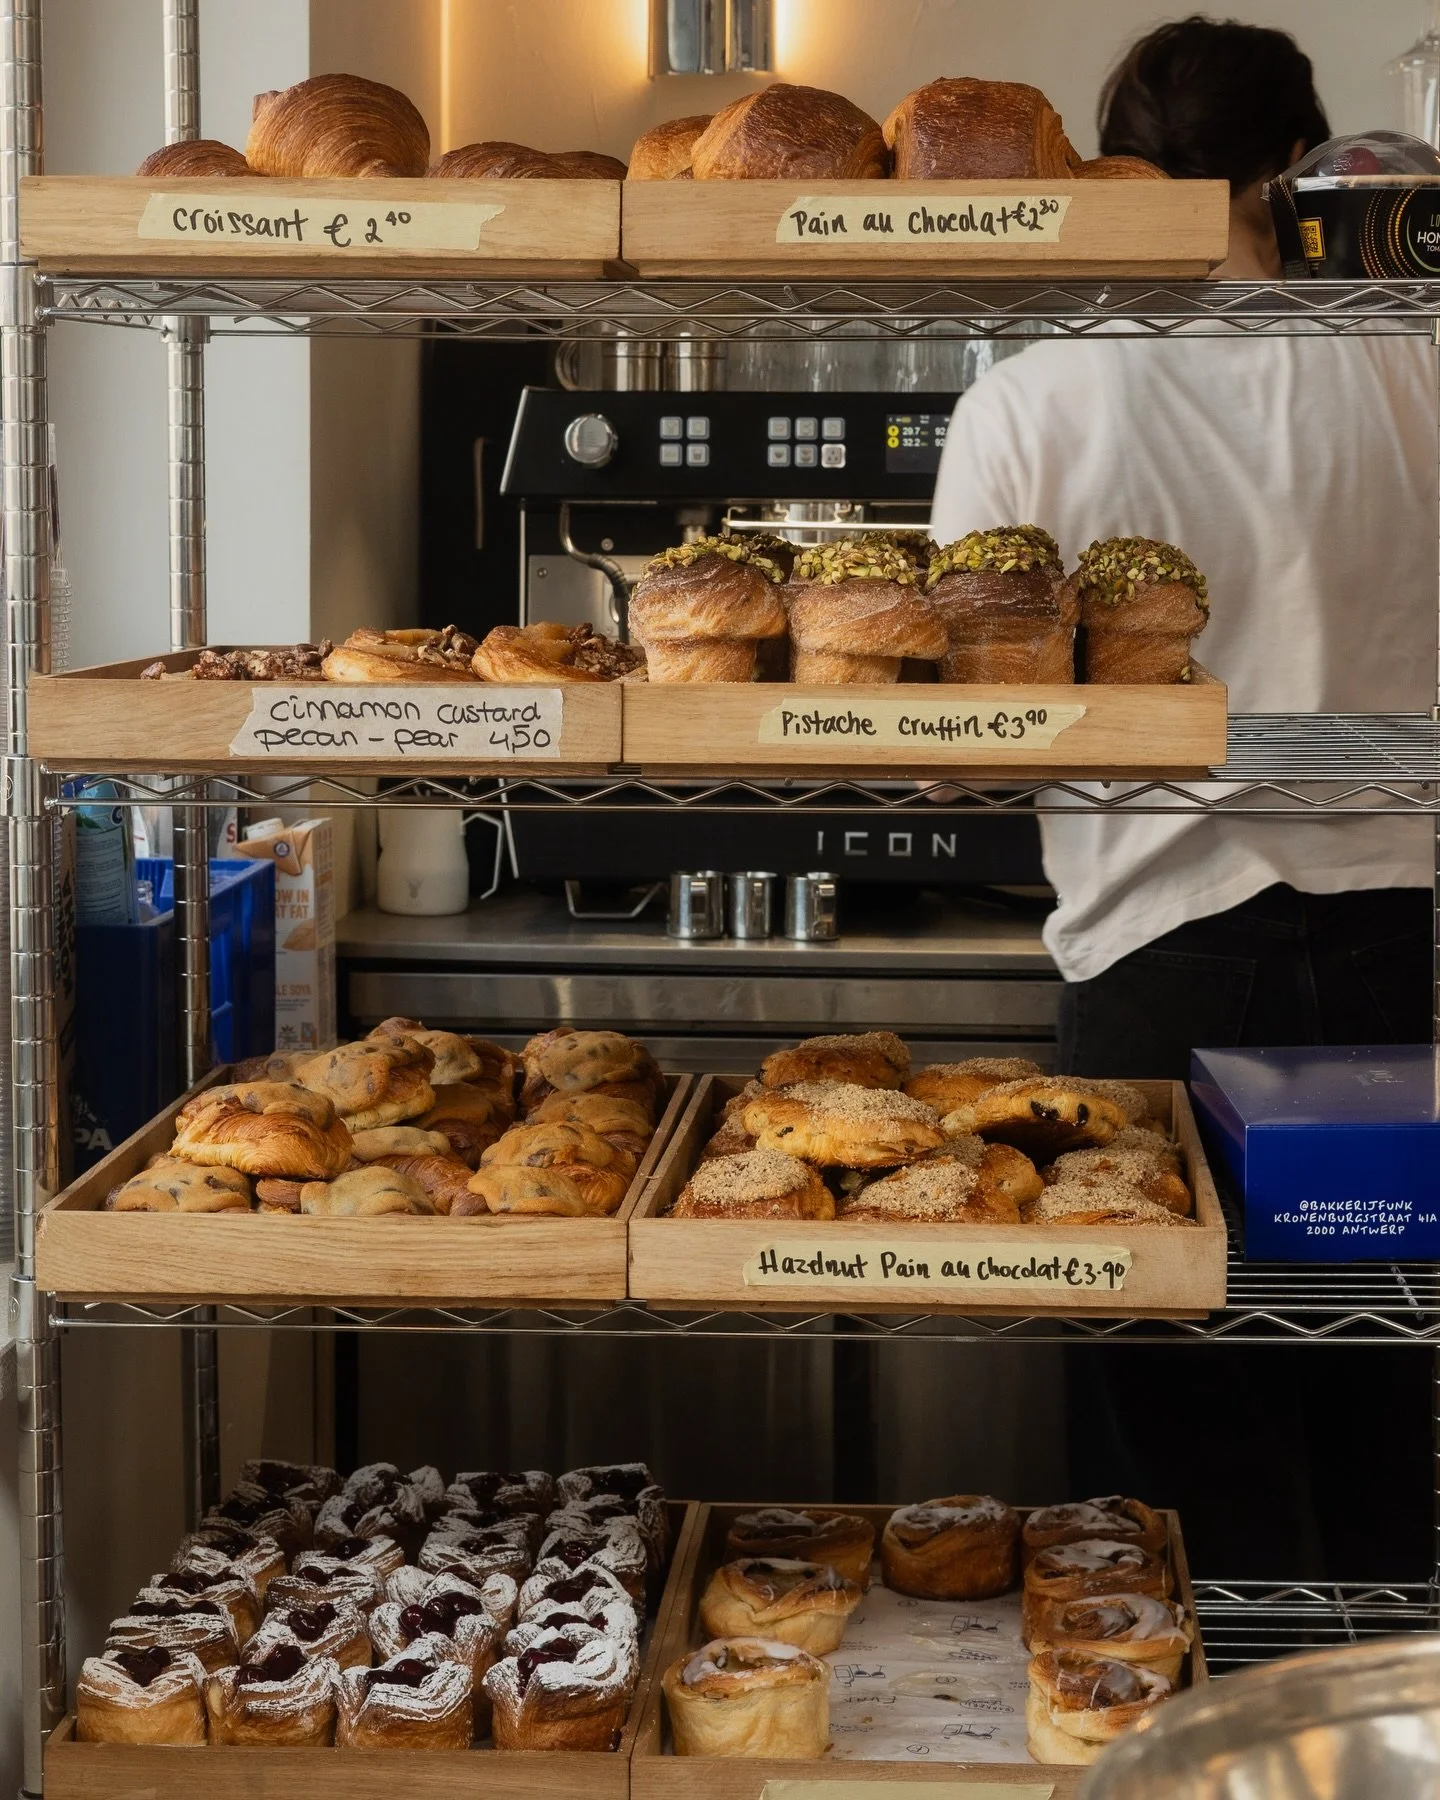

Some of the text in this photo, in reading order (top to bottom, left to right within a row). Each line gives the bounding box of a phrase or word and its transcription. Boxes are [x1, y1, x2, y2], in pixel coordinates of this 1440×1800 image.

[790, 211, 848, 236] Pain
[862, 211, 894, 233] au
[781, 710, 877, 736] Pistache
[393, 728, 459, 754] pear
[817, 831, 957, 857] ICON
[290, 904, 310, 920] FAT
[1273, 1212, 1412, 1223] KRONENBURGSTRAAT
[1299, 1200, 1413, 1211] @BAKKERIJFUNK
[1306, 1224, 1406, 1235] 2000 ANTWERP
[880, 1251, 931, 1278] Pain
[940, 1260, 971, 1278] au
